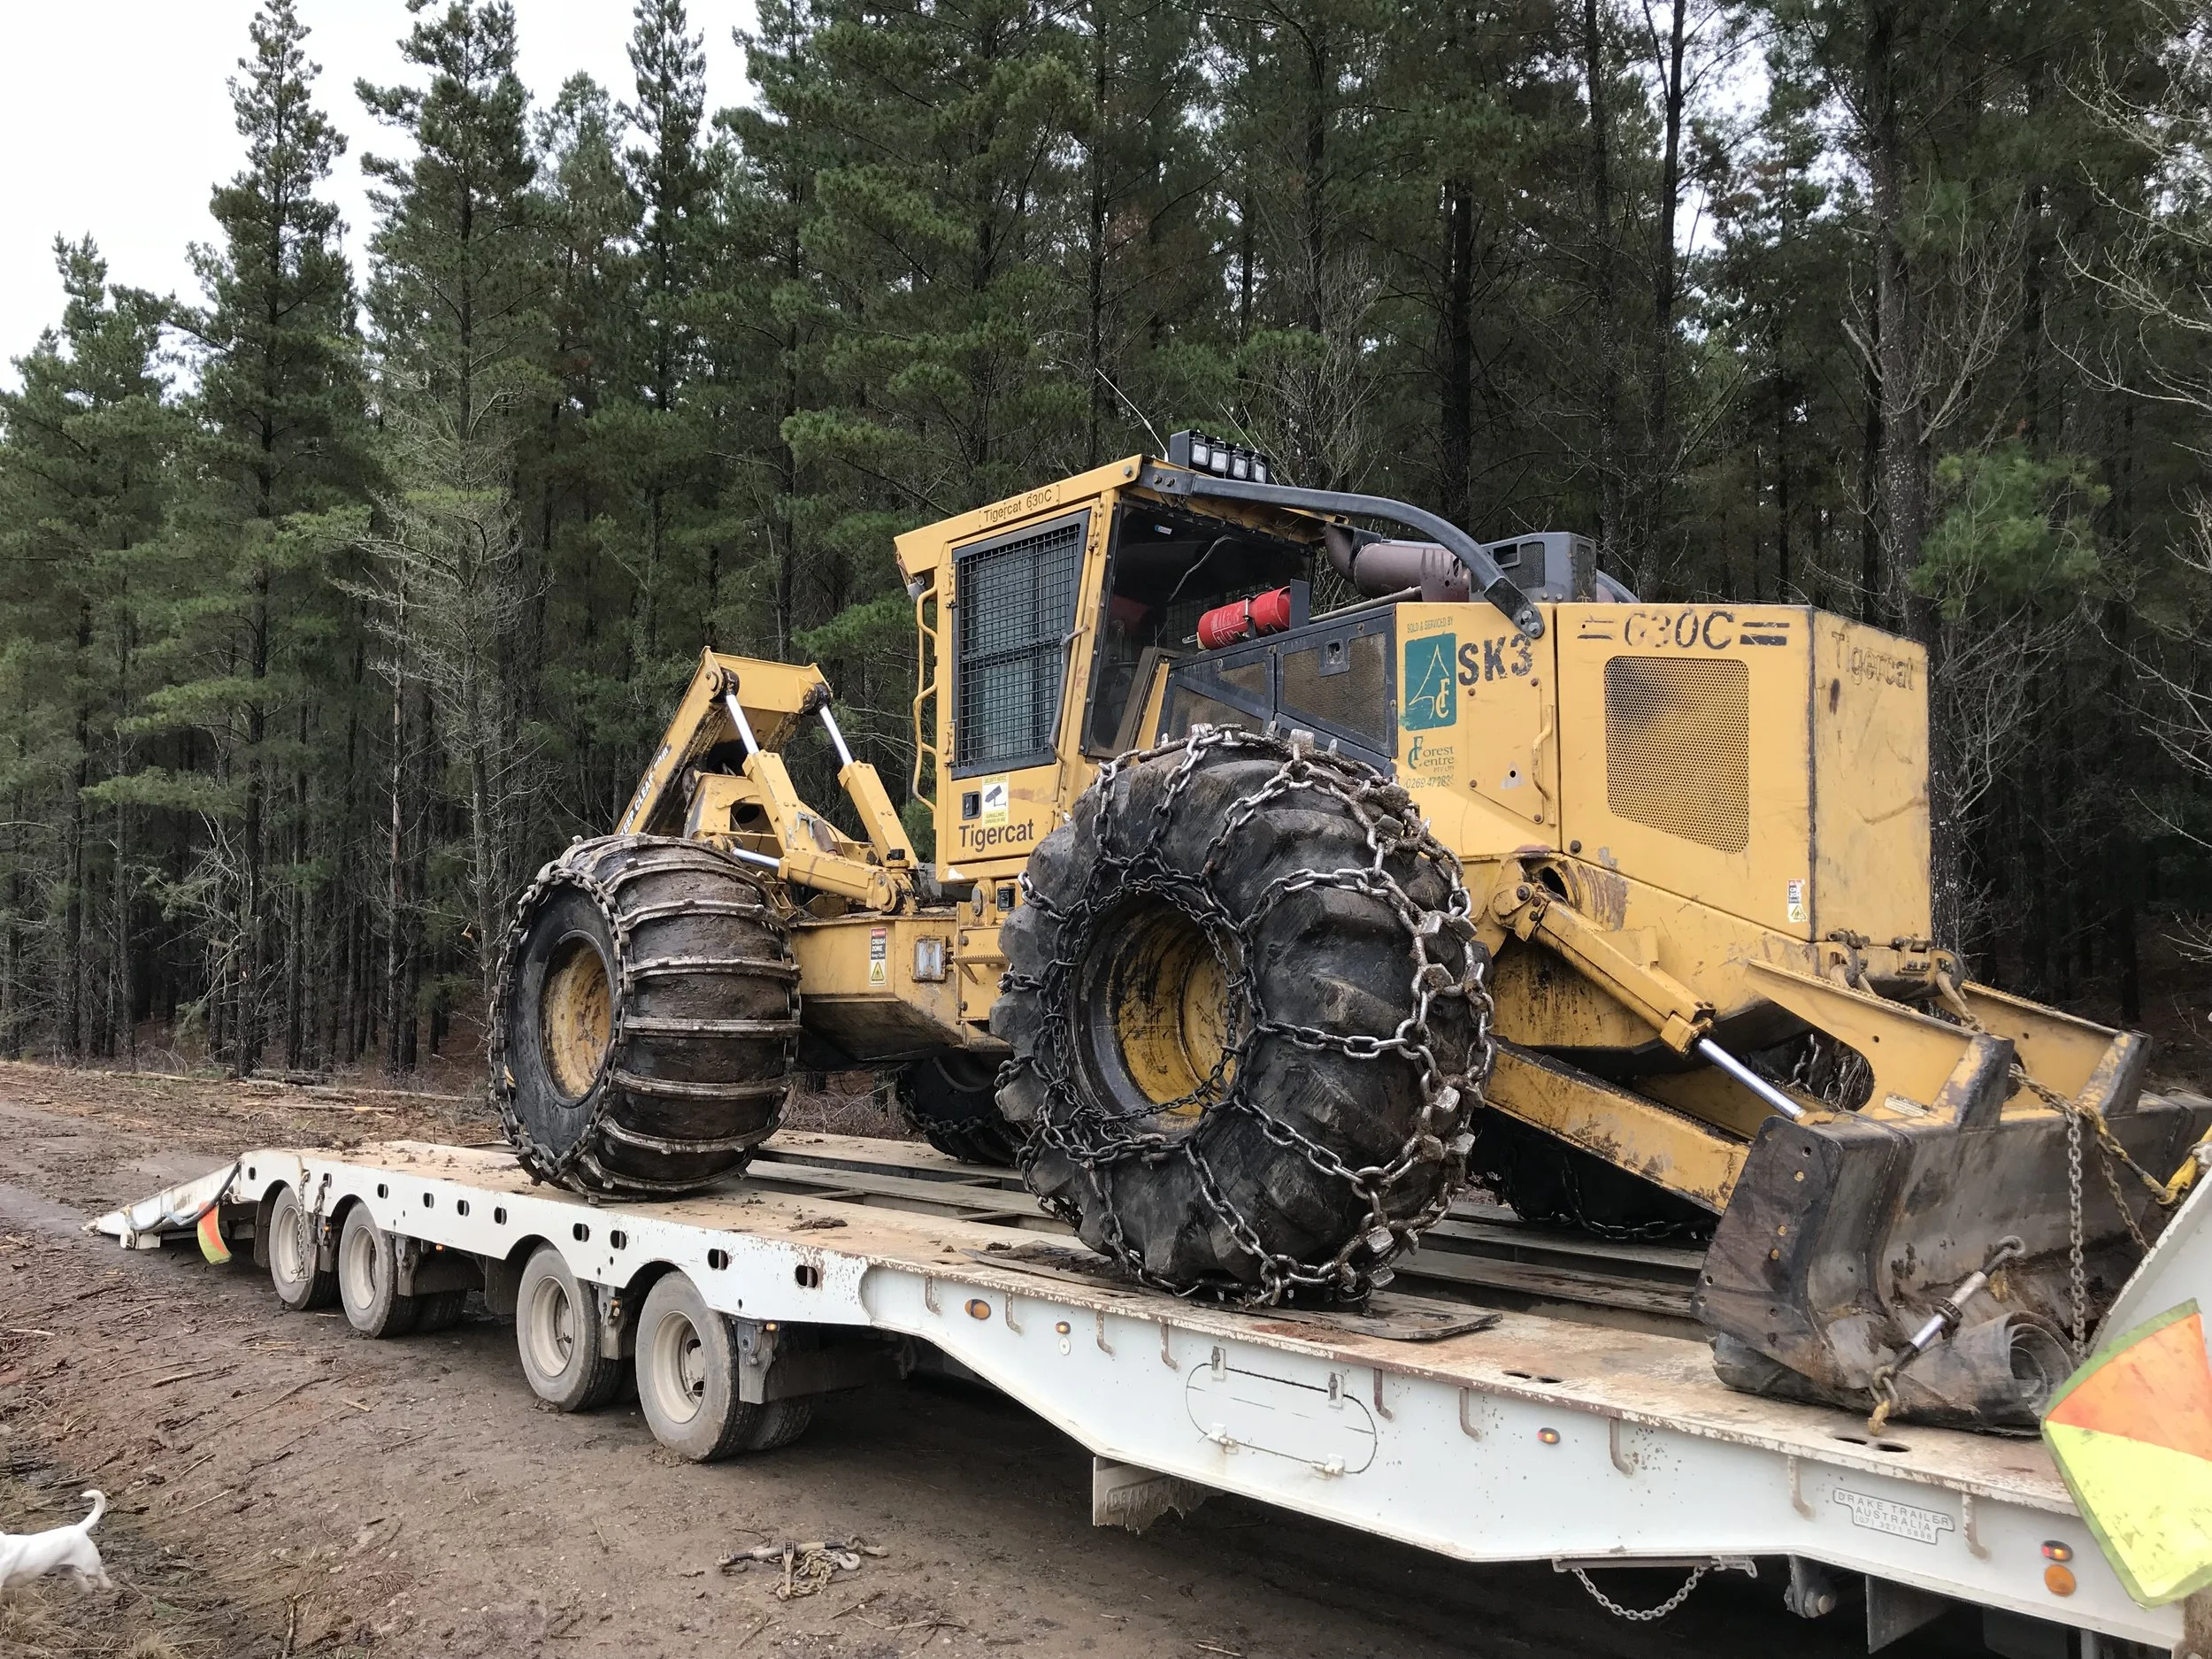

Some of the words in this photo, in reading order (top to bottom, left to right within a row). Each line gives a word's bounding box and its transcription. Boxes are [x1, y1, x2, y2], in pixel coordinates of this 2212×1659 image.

[984, 500, 1022, 523] Tigercat
[1026, 488, 1052, 509] 630C
[1624, 608, 1734, 650] 630C
[1457, 633, 1533, 687] SK3
[1831, 630, 1914, 691] Tigercat
[1407, 747, 1455, 770] Centre
[1412, 735, 1454, 761] Forest
[958, 818, 1034, 853] Tigercat
[1838, 1492, 1884, 1511] DRAKE
[1890, 1505, 1949, 1526] TRAILER
[1855, 1506, 1932, 1532] AUSTRALIA
